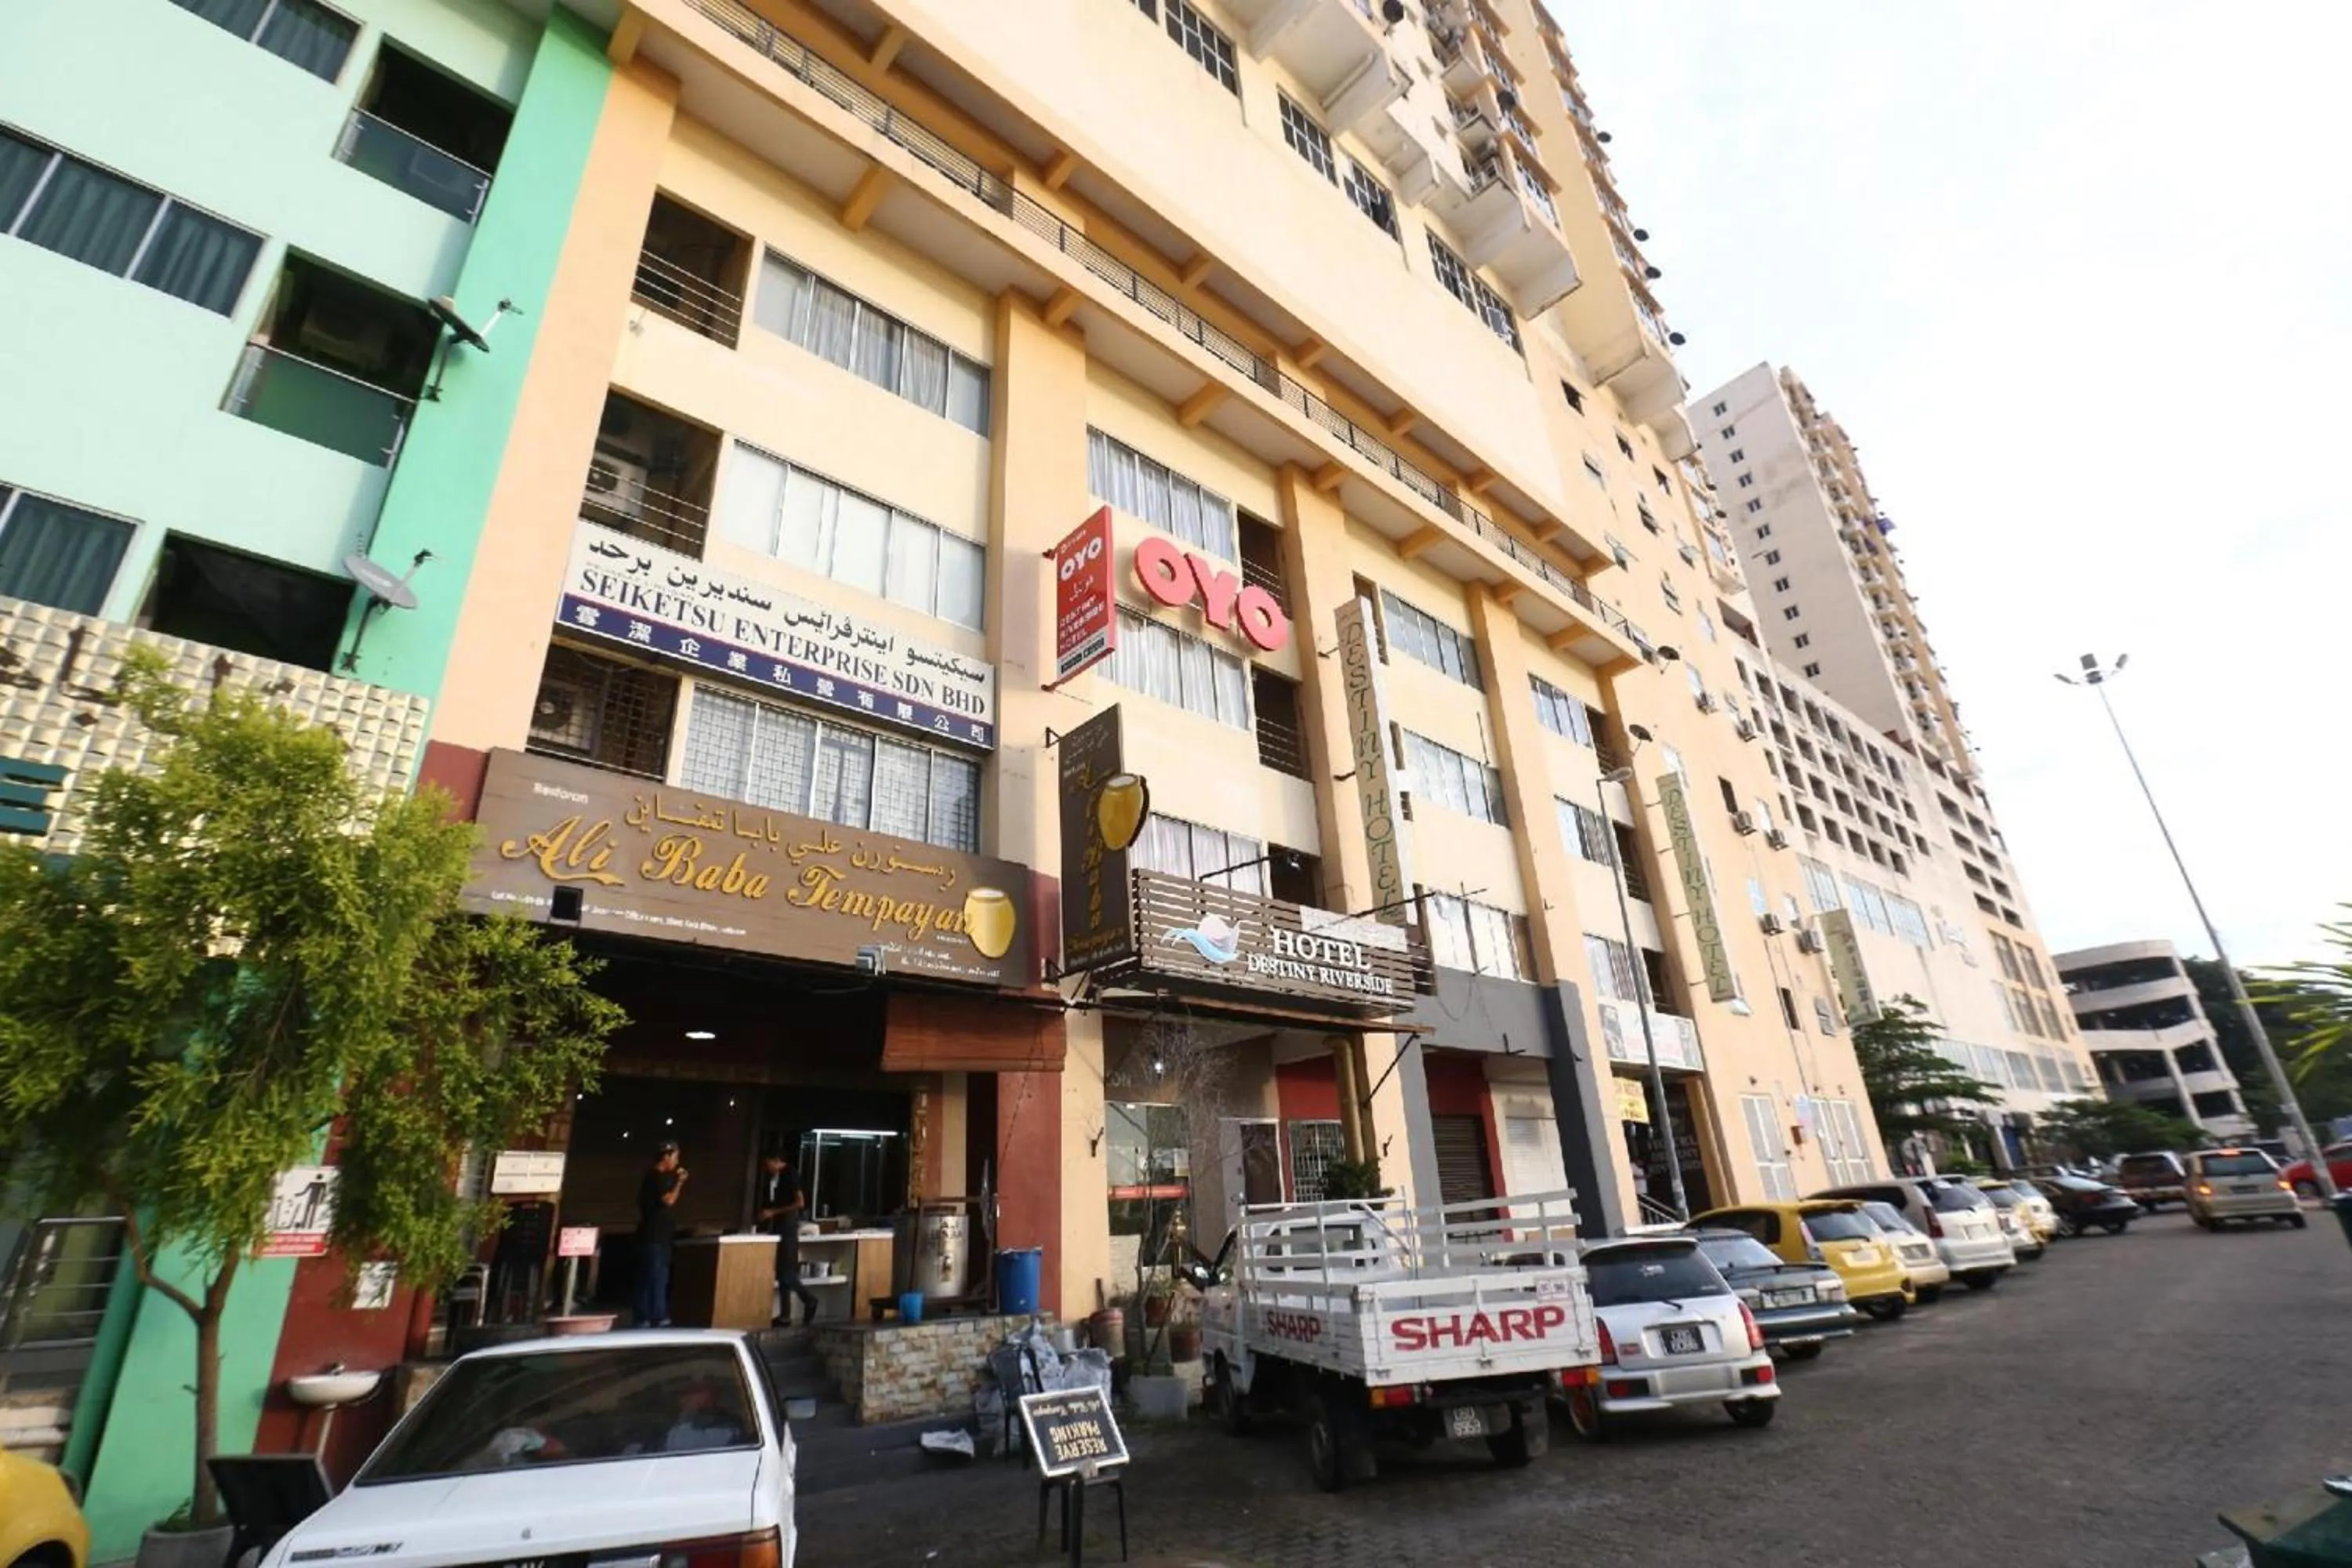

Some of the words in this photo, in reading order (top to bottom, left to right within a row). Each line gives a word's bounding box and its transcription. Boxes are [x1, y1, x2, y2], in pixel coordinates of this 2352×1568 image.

[1061, 537, 1102, 580] OYO
[1134, 536, 1293, 652] OYO
[579, 568, 726, 633] SEIKETSU
[734, 618, 887, 685] ENTERPRISE
[891, 670, 935, 699] SDN
[942, 684, 985, 715] BHD
[1342, 620, 1385, 781] DESTINY
[1366, 792, 1404, 917] HOTEL
[733, 808, 781, 851] بابا
[786, 829, 842, 865] علي
[500, 814, 626, 887] Ali
[641, 833, 768, 902] Baba
[786, 864, 976, 942] Tempayan
[1247, 952, 1316, 982] DESTINY
[1270, 925, 1372, 971] HOTEL
[1693, 913, 1729, 995] HOTEL
[1266, 1309, 1322, 1343] SHARP
[1390, 1305, 1566, 1352] SHARP
[1048, 1420, 1102, 1443] PARKING
[1054, 1437, 1109, 1462] RESERVE
